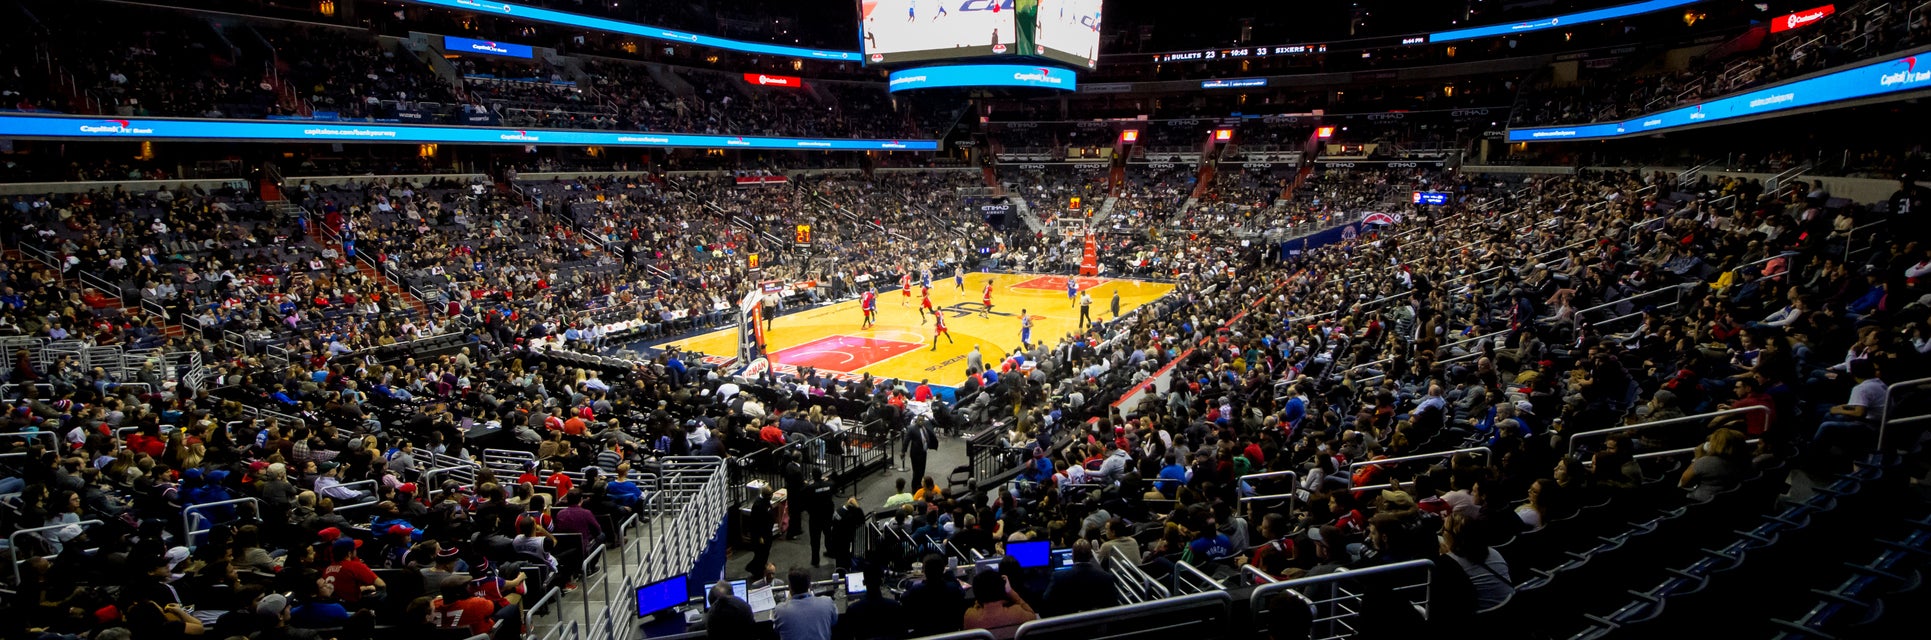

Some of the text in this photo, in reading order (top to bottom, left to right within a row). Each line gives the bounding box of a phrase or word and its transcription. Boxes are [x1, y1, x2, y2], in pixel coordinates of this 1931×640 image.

[1171, 52, 1202, 60] BULLETS
[1205, 51, 1216, 59] 23
[1275, 46, 1305, 54] SIXERS
